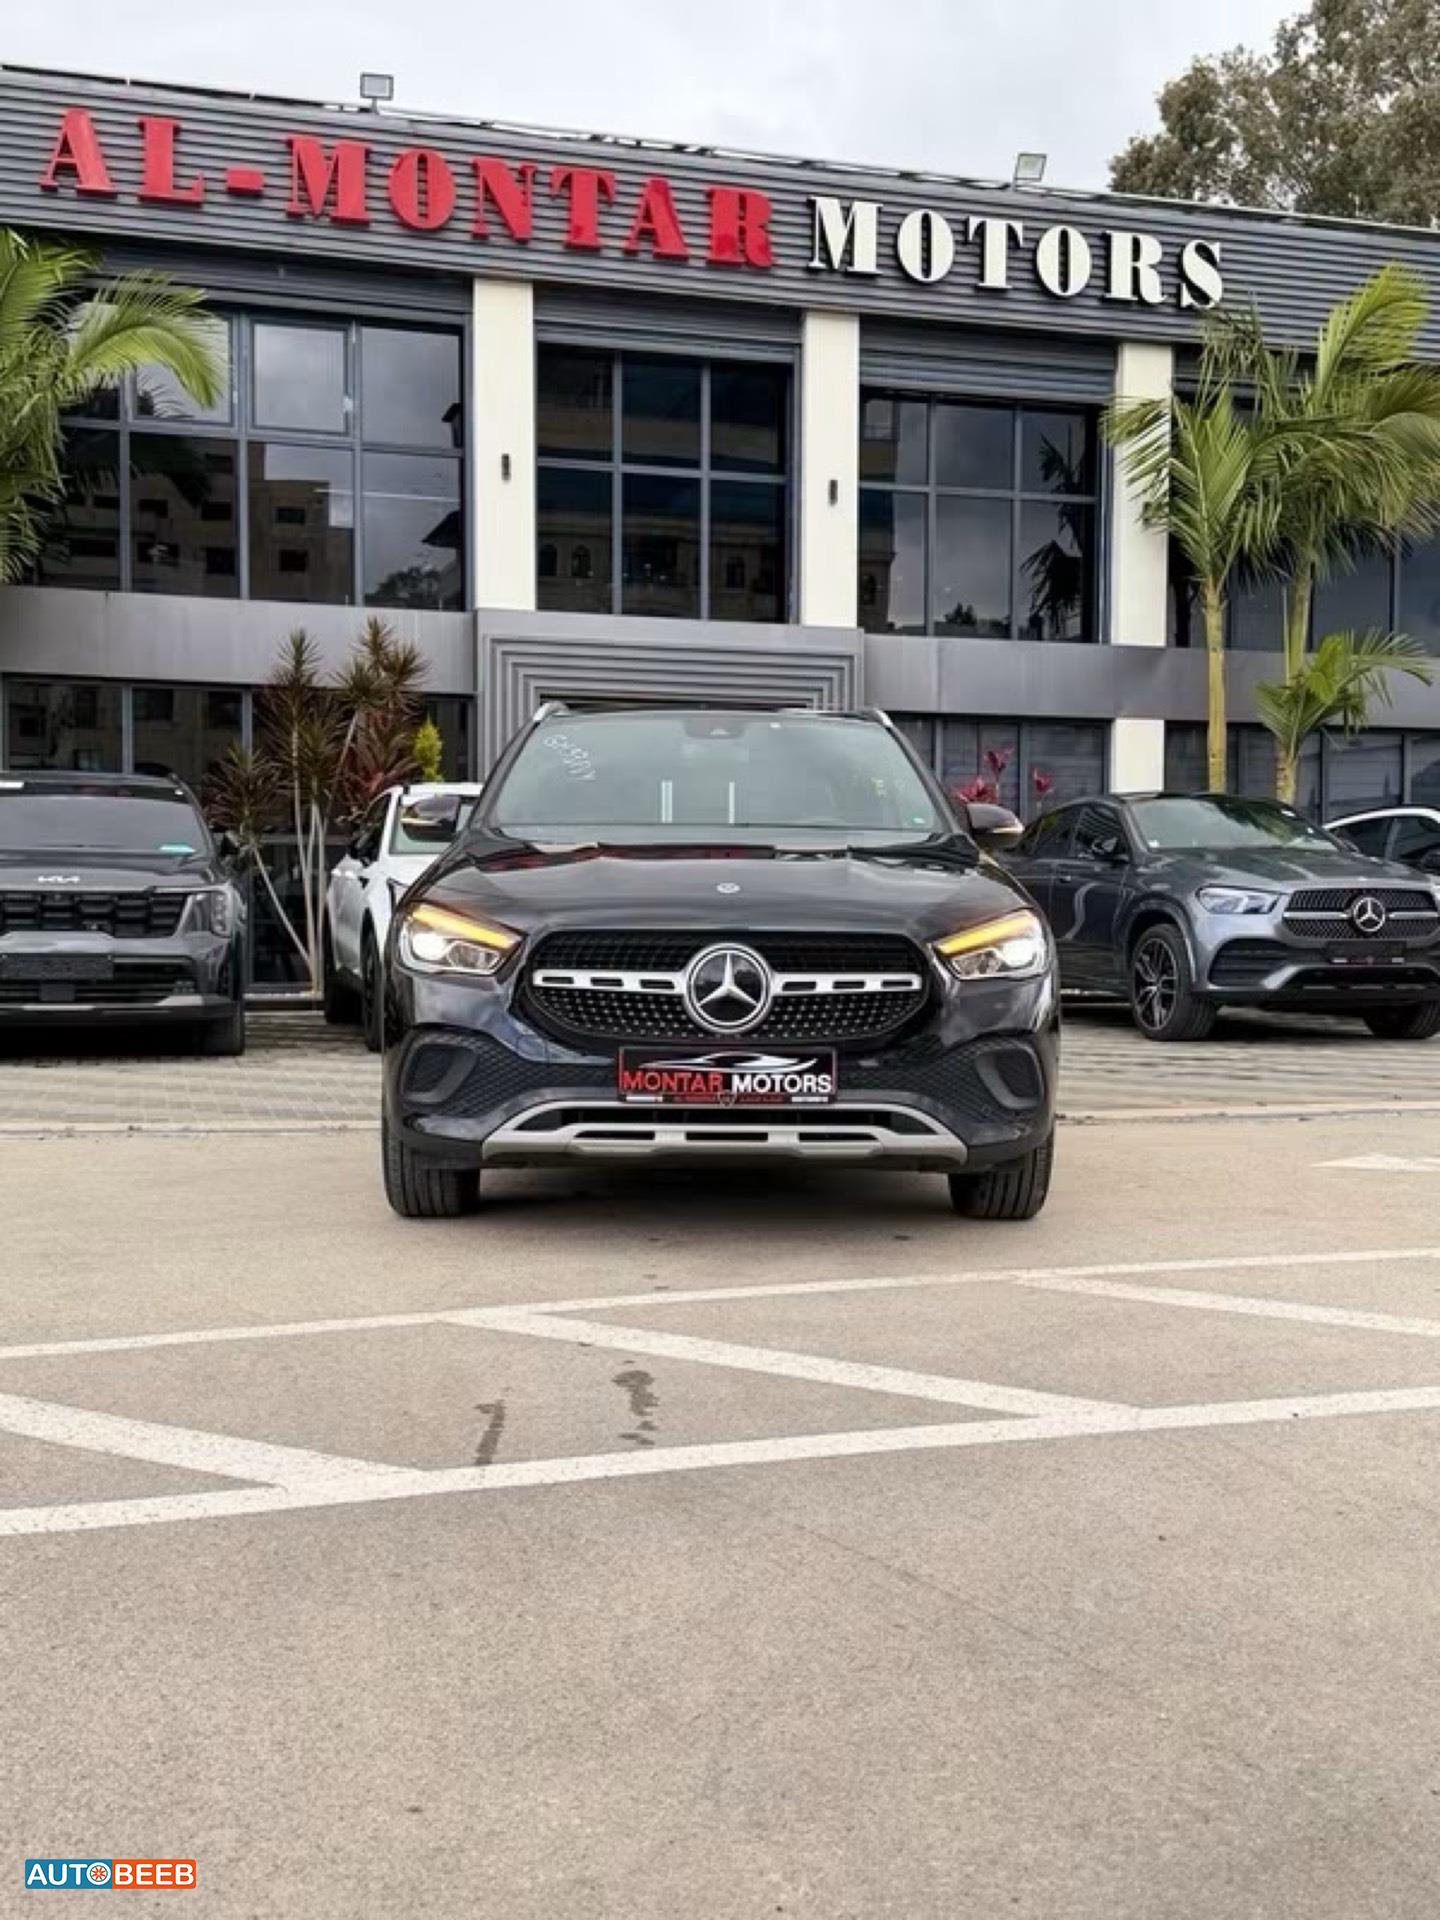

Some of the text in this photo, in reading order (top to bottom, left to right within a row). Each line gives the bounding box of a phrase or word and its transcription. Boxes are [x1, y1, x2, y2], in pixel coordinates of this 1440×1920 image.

[39, 107, 1225, 310] AL-MONTAR MOTORS
[622, 1071, 832, 1094] MONTAR MOTORS
